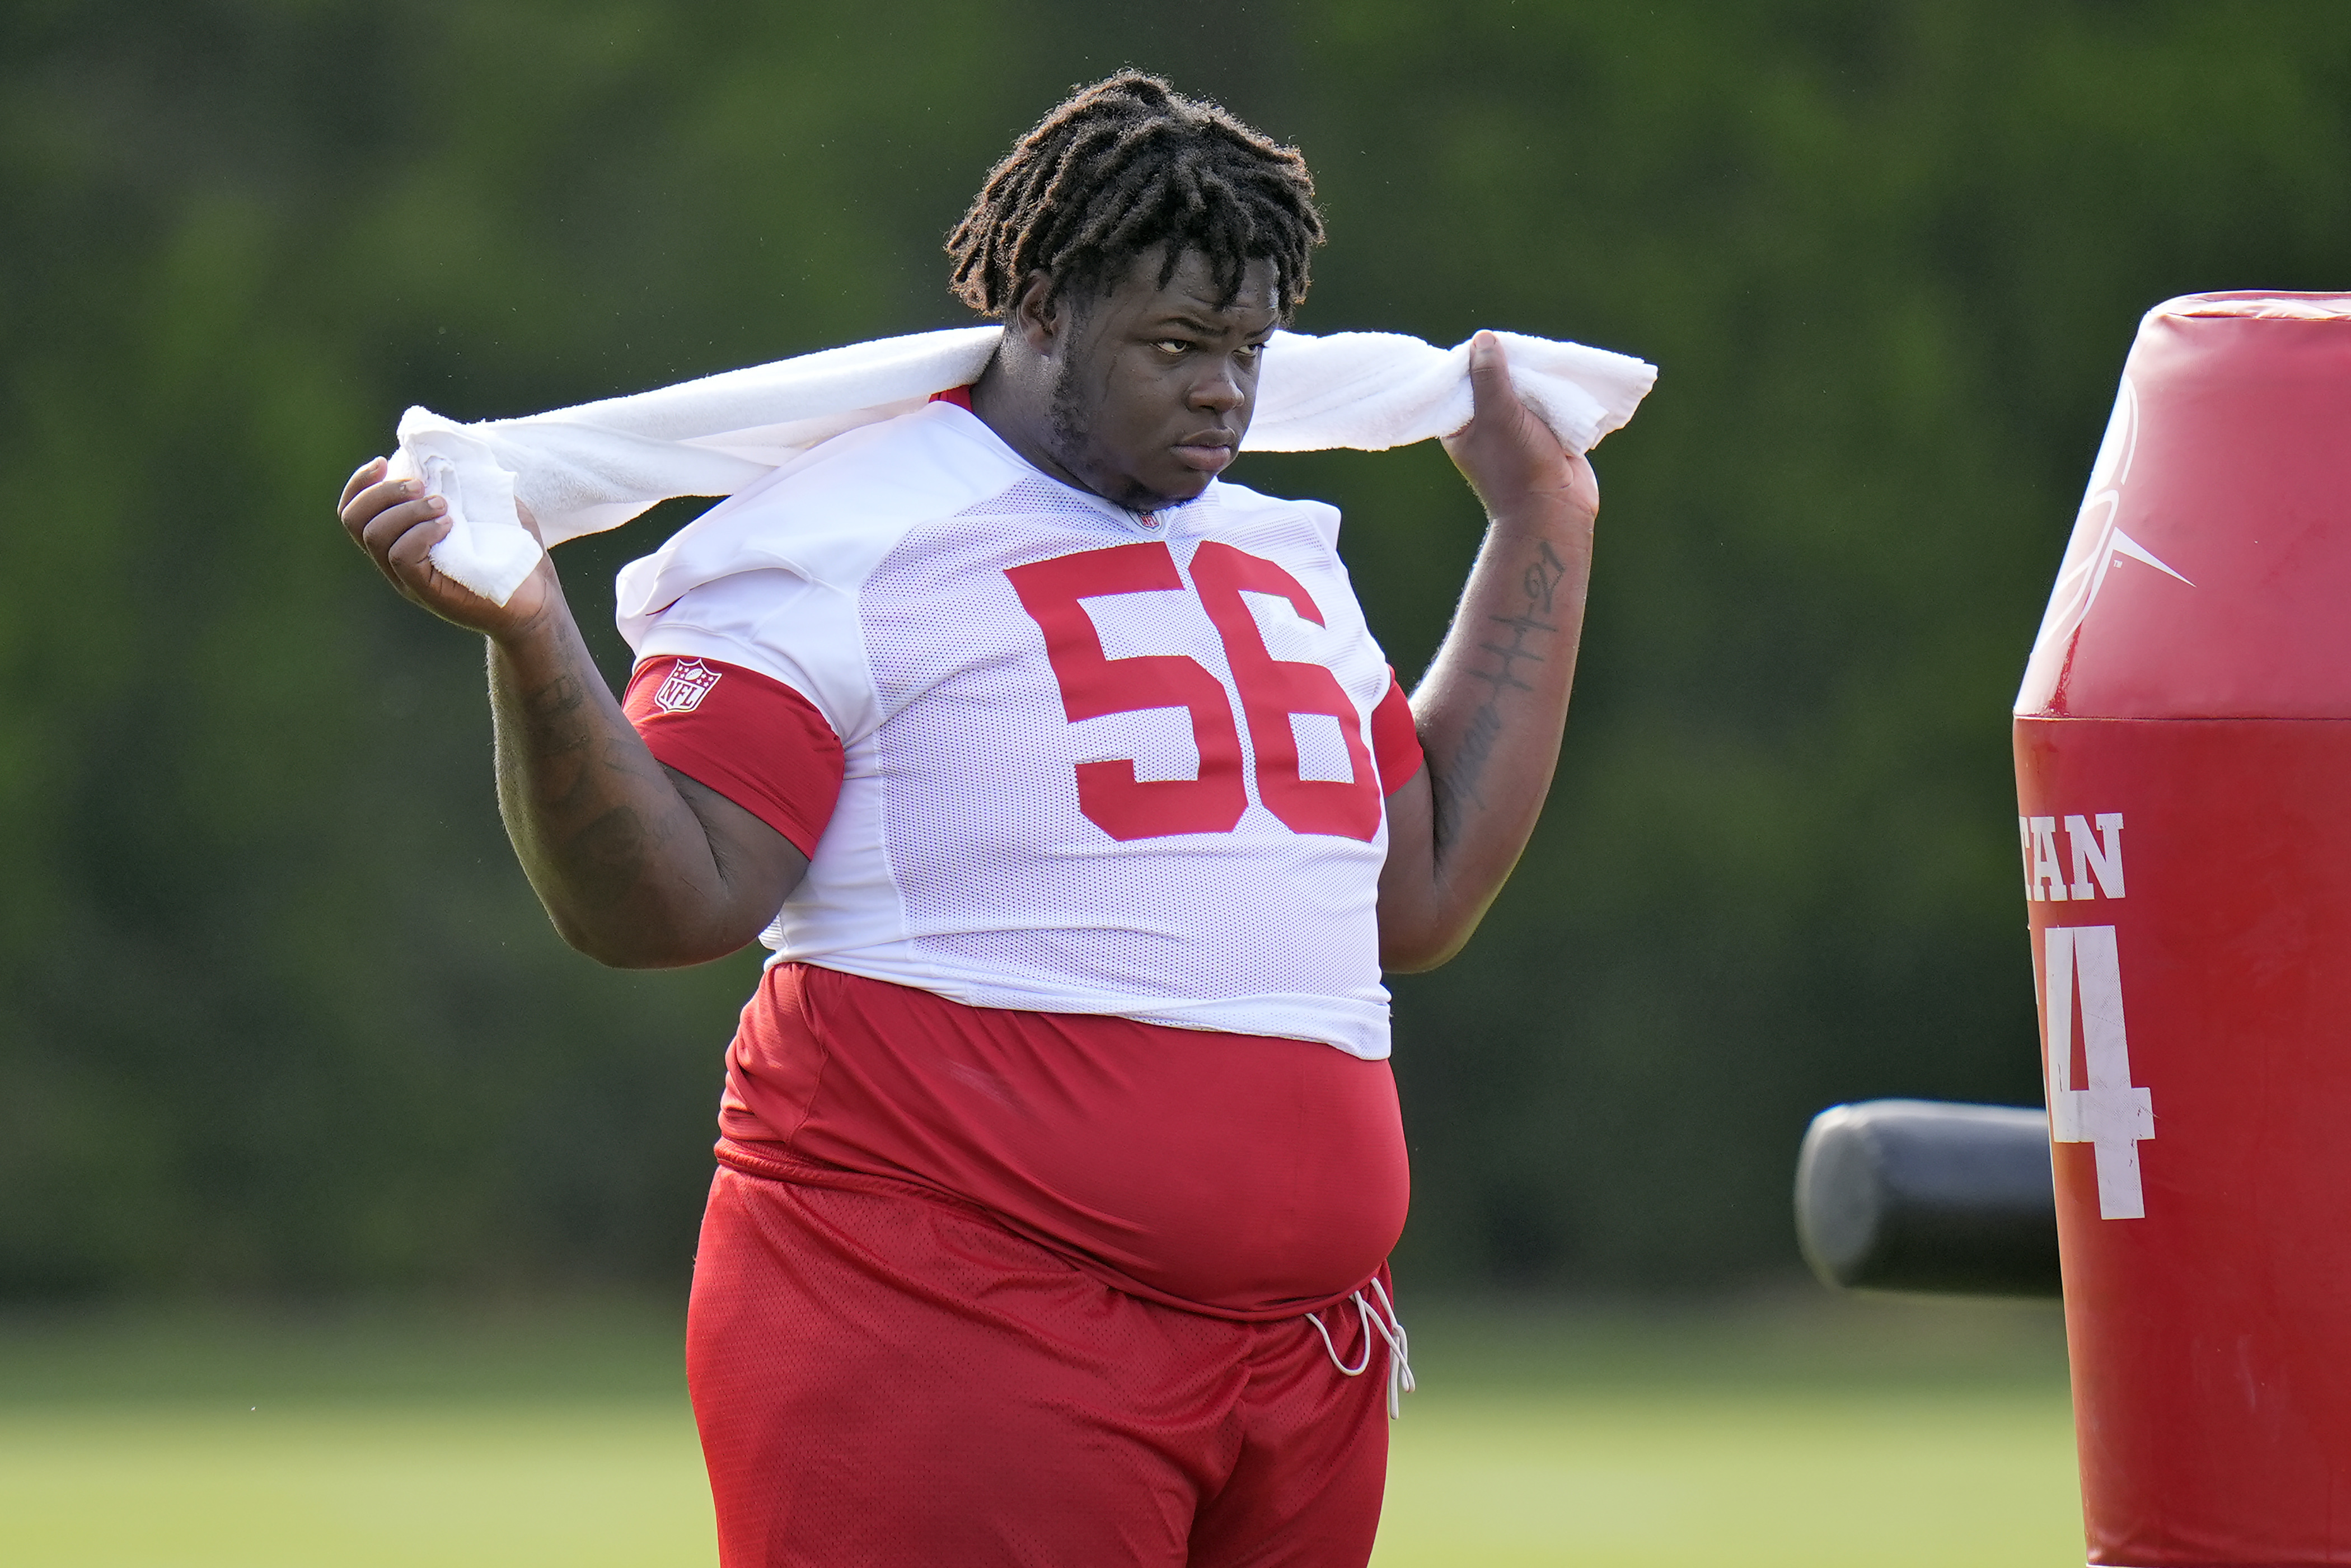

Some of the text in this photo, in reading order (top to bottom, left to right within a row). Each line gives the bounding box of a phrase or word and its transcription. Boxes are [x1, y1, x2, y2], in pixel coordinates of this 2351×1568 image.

[1140, 516, 1158, 527] NFL
[661, 679, 698, 707] NFL
[1003, 540, 1382, 844] 56
